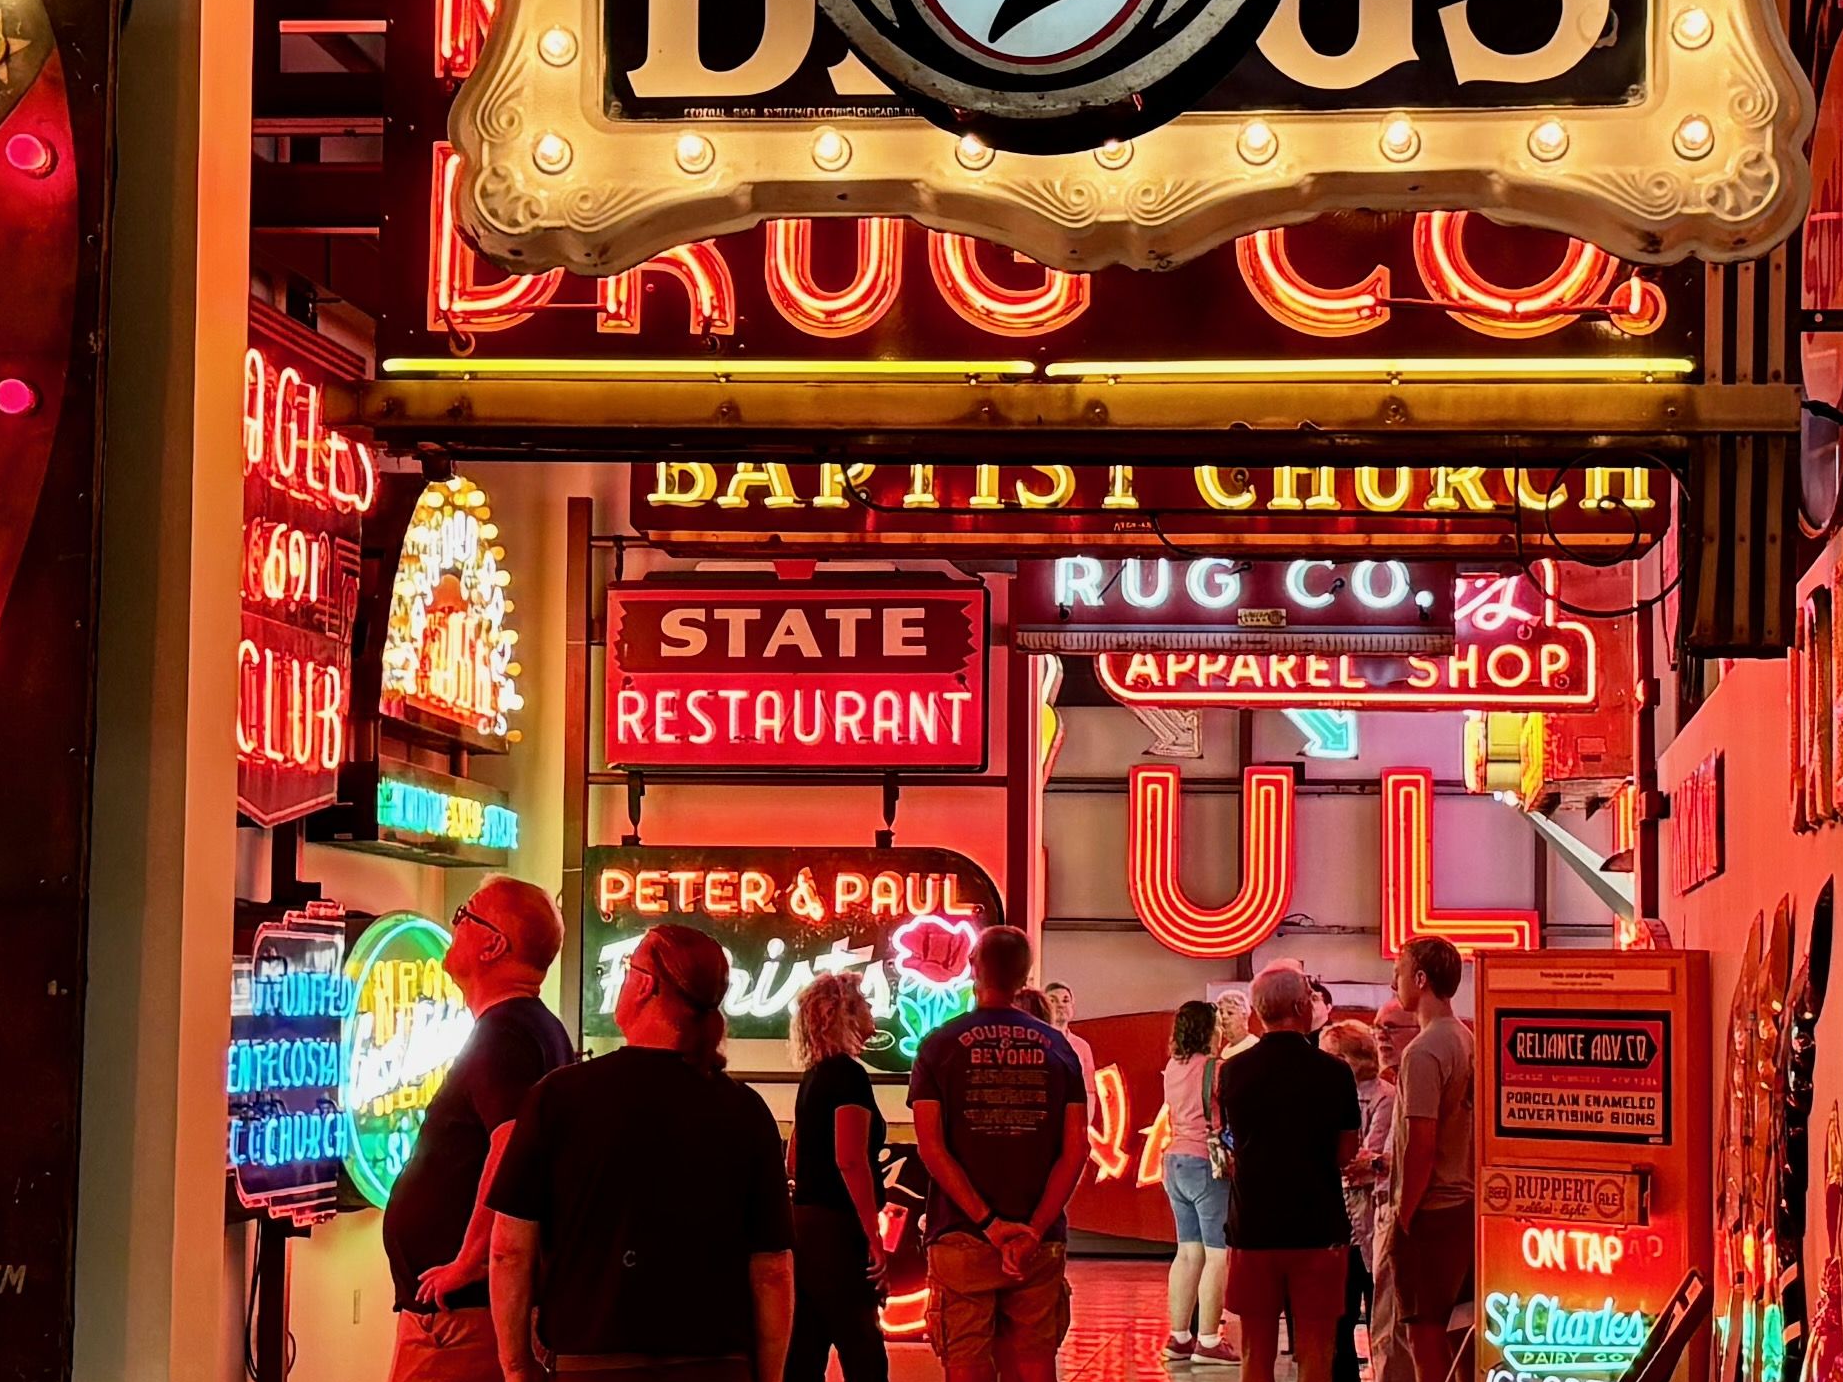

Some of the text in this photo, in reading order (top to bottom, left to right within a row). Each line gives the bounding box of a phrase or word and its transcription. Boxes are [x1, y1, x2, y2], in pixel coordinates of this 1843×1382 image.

[1055, 556, 1242, 609] RUG
[1285, 557, 1434, 609] CO.
[660, 607, 927, 658] STATE
[1125, 643, 1570, 688] APPAREL SHOP
[237, 639, 343, 771] CLUB
[617, 690, 973, 746] RESTAURANT
[599, 866, 974, 921] PETER & PAUL
[957, 1025, 1053, 1049] BOURBON
[970, 1048, 1045, 1065] BEYOND
[1516, 1032, 1649, 1063] RELIANCE ADV. CO.
[1506, 1091, 1656, 1111] PORCELAIN ENAMELED
[1506, 1107, 1656, 1127] ADVERTISING SIGNS
[264, 1113, 350, 1166] CHURCH
[1514, 1175, 1596, 1203] RUPPERT
[1597, 1192, 1619, 1207] ALE
[1522, 1227, 1624, 1275] ON TAP
[1525, 1293, 1645, 1345] Charles
[1522, 1351, 1633, 1365] DAIRY CO.
